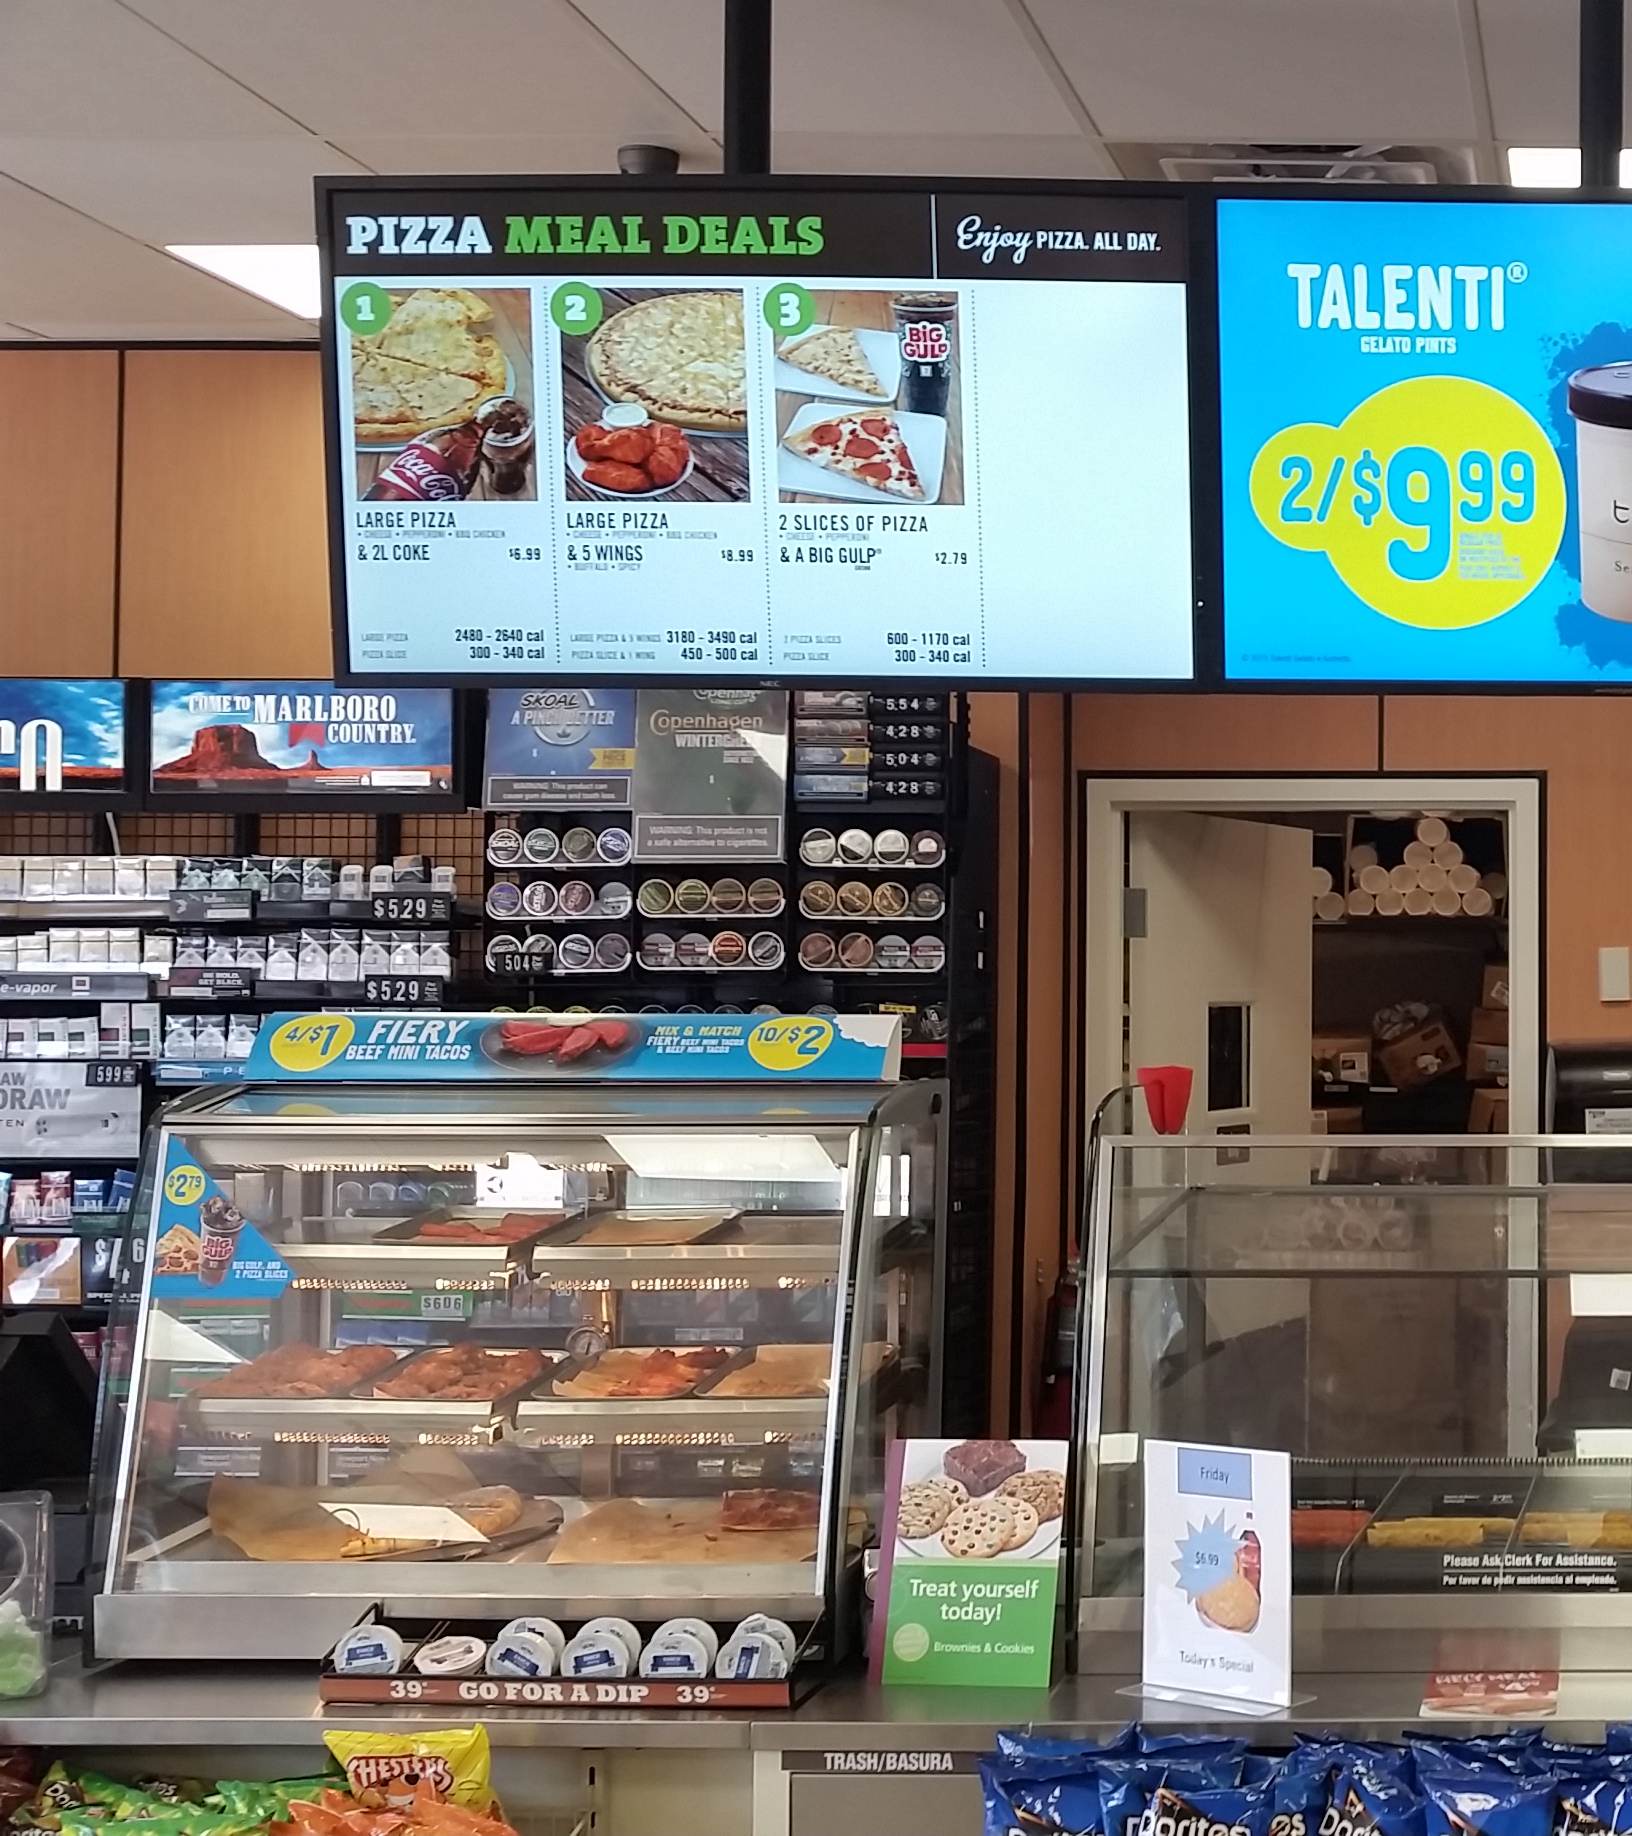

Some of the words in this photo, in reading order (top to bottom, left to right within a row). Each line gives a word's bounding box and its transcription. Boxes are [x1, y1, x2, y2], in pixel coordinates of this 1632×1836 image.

[346, 216, 492, 254] PIZZA
[504, 216, 650, 254] MEAL
[662, 216, 824, 255] DEALS
[957, 216, 1034, 264] Enjoy
[1036, 231, 1089, 250] PIZZA.
[1093, 232, 1122, 251] ALL
[1126, 232, 1161, 252] DAY.
[356, 296, 374, 320] 1
[566, 296, 587, 320] 2
[778, 293, 800, 327] 3
[1361, 336, 1411, 354] GELATO
[1415, 336, 1456, 354] PINTS
[356, 512, 404, 528] LARGE
[411, 512, 456, 528] PIZZA
[567, 513, 616, 528] LARGE
[623, 513, 668, 528] PIZZA
[779, 515, 787, 530] 2
[794, 515, 849, 531] SLICES
[856, 515, 874, 531] OF
[883, 516, 928, 532] PIZZA
[358, 545, 367, 560] &
[373, 545, 388, 560] 2L
[393, 545, 430, 560] COKE
[568, 545, 577, 561] &
[583, 545, 590, 560] 5
[595, 545, 643, 561] WINGS
[780, 547, 790, 562] &
[796, 547, 804, 562] A
[809, 548, 833, 563] BIG
[455, 630, 482, 641] 2480
[495, 630, 522, 641] 2640
[526, 630, 544, 641] cal
[667, 631, 694, 643] 3180
[707, 632, 735, 643] 3490
[739, 632, 757, 643] cal
[887, 633, 908, 644] 600
[921, 633, 948, 645] 1170
[953, 634, 970, 645] cal
[470, 647, 490, 658] 300
[503, 647, 524, 658] 340
[527, 647, 545, 658] cal
[681, 648, 702, 660] 450
[715, 648, 736, 660] 500
[741, 649, 758, 660] cal
[895, 650, 915, 662] 300
[929, 651, 949, 662] 340
[953, 651, 970, 662] cal
[521, 692, 580, 708] SKOAL
[189, 696, 231, 713] COME
[233, 696, 250, 710] TO
[253, 695, 396, 723] MARLBORO
[511, 711, 520, 724] A
[650, 709, 762, 735] Copenhagen
[714, 826, 744, 835] product
[367, 1020, 469, 1043] FIERY
[345, 1045, 385, 1060] BEEF
[388, 1045, 419, 1059] MINI
[425, 1045, 471, 1060] TACOS
[1200, 1467, 1229, 1484] Friday
[1443, 1554, 1479, 1567] Please
[1482, 1554, 1501, 1567] Ask
[1505, 1554, 1532, 1566] Clerk
[1535, 1554, 1552, 1566] For
[910, 1579, 957, 1597] Treat
[961, 1579, 1039, 1601] yourself
[940, 1603, 1002, 1625] today!
[934, 1642, 981, 1653] Brownies
[984, 1643, 991, 1652] &
[995, 1643, 1035, 1654] Cookies
[1219, 1657, 1253, 1672] Special
[459, 1682, 499, 1700] GO
[505, 1683, 564, 1701] FOR
[570, 1684, 590, 1701] A
[596, 1685, 649, 1702] DIP
[824, 1753, 953, 1772] TRASH/BASURA
